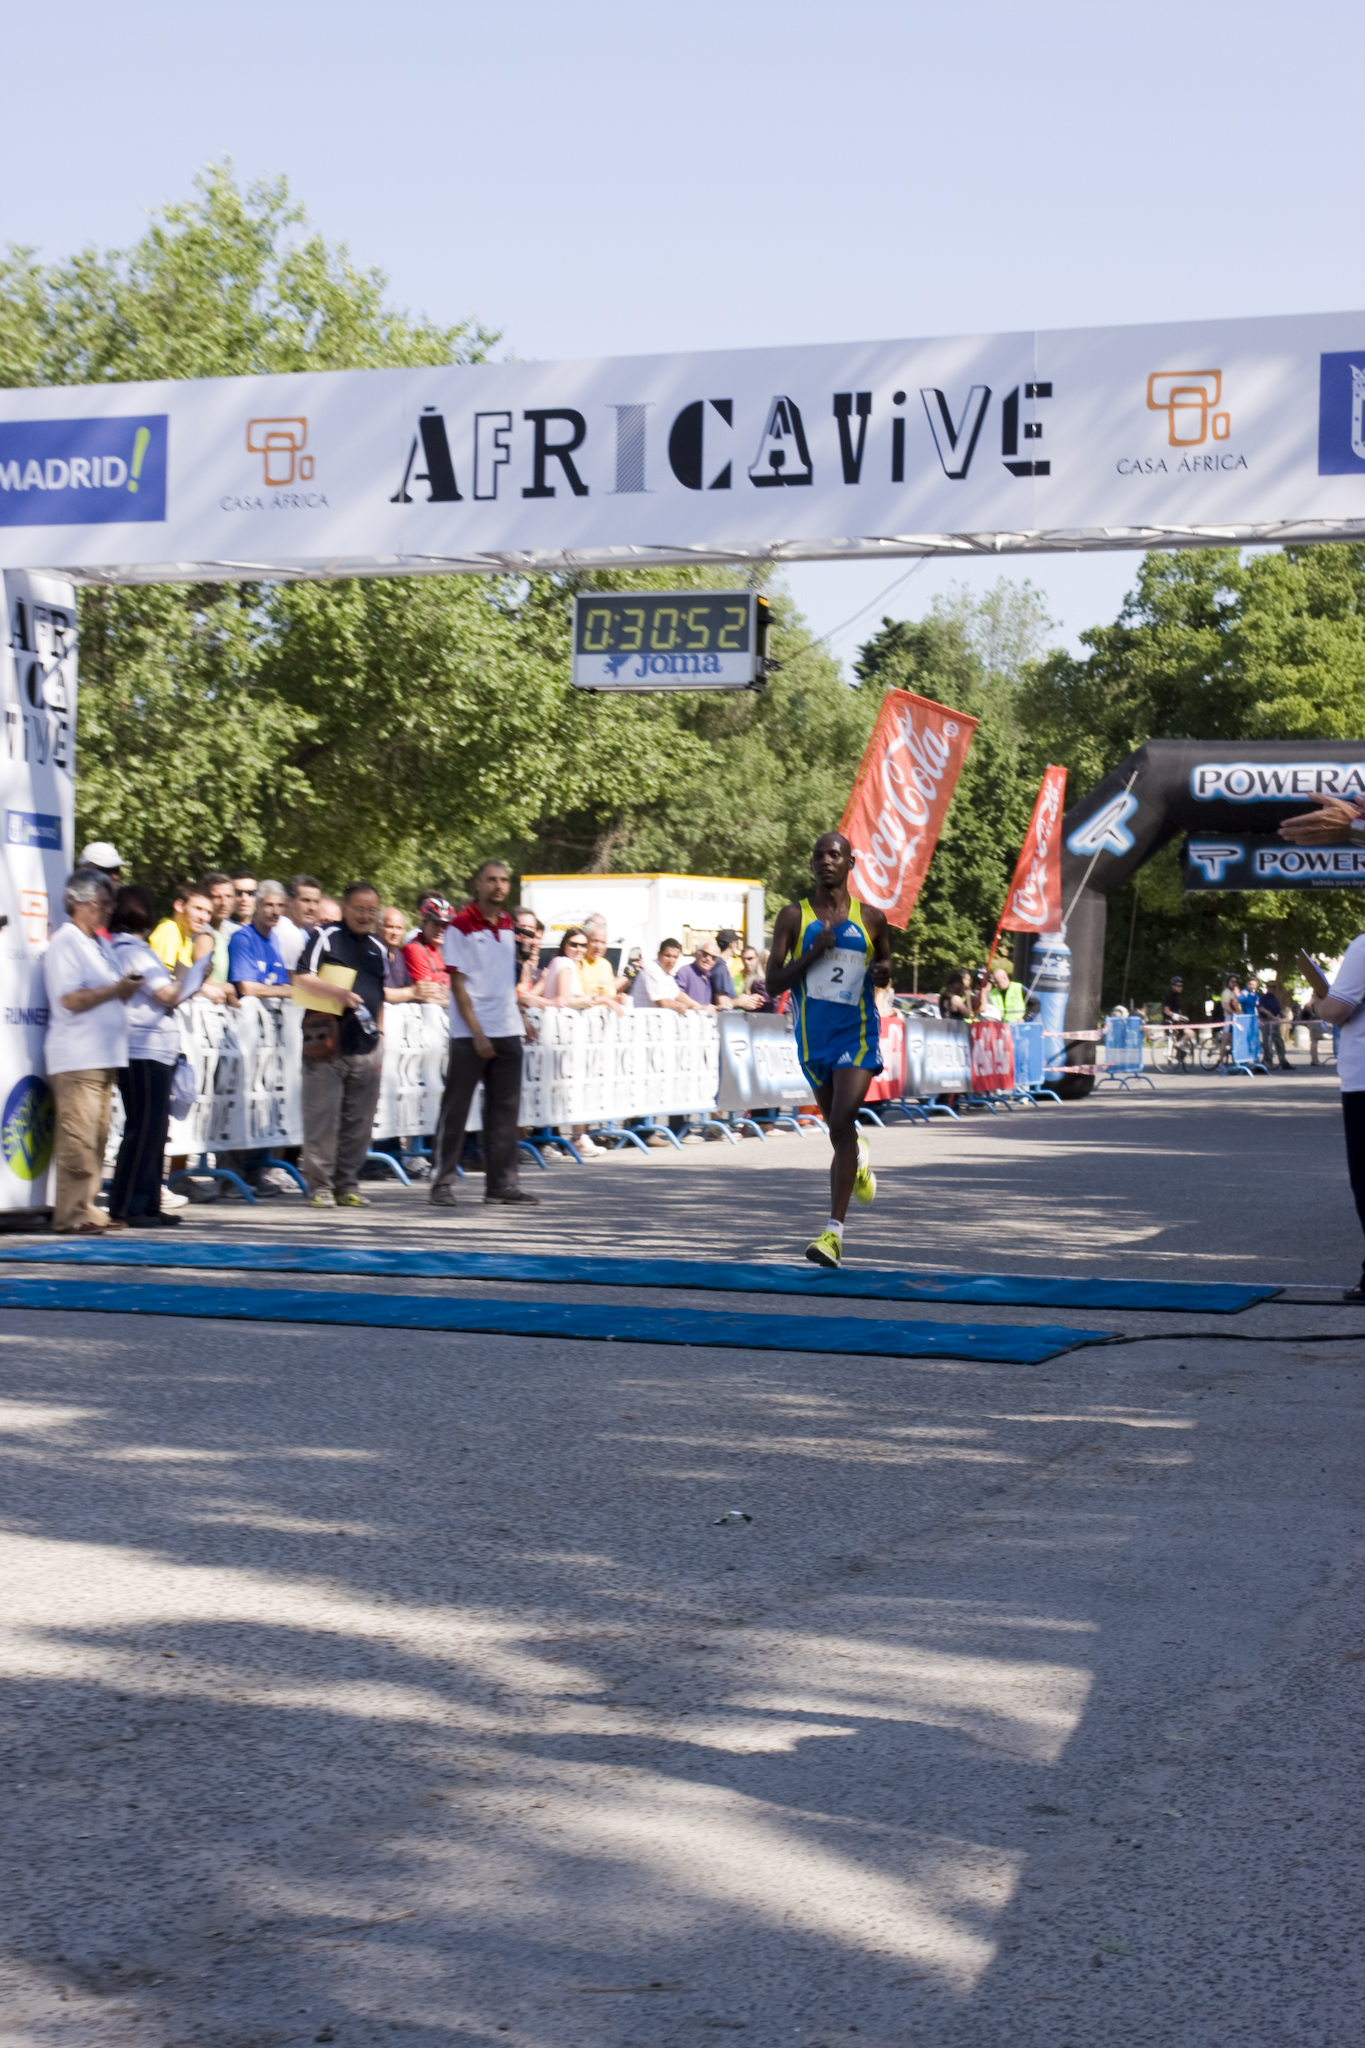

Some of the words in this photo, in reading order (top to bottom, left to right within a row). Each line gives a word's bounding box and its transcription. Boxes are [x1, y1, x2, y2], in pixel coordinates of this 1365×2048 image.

[1116, 458, 1168, 475] CASA
[220, 496, 265, 512] CASA
[830, 967, 844, 983] 2
